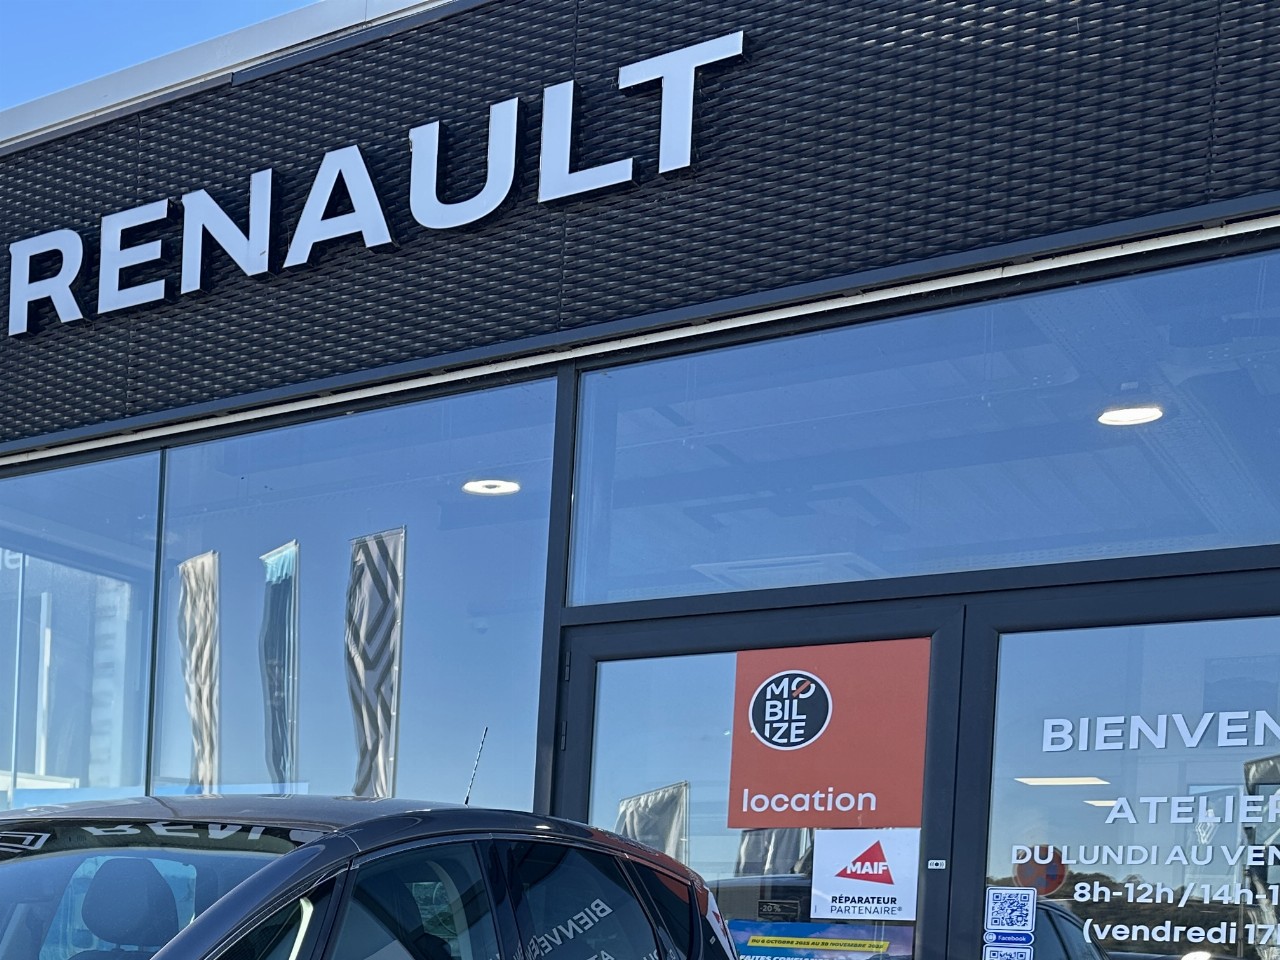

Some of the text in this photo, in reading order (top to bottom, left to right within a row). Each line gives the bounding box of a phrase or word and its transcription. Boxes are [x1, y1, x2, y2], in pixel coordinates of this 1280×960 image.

[8, 30, 745, 338] RENAULT
[742, 787, 877, 812] location
[1011, 845, 1054, 864] DU
[1061, 845, 1157, 865] LUNDI
[1165, 845, 1213, 866] AU
[846, 861, 889, 875] MAIF
[831, 894, 897, 905] RÉPARATEUR
[998, 934, 1026, 943] Facebook
[1083, 919, 1236, 945] (vendredi
